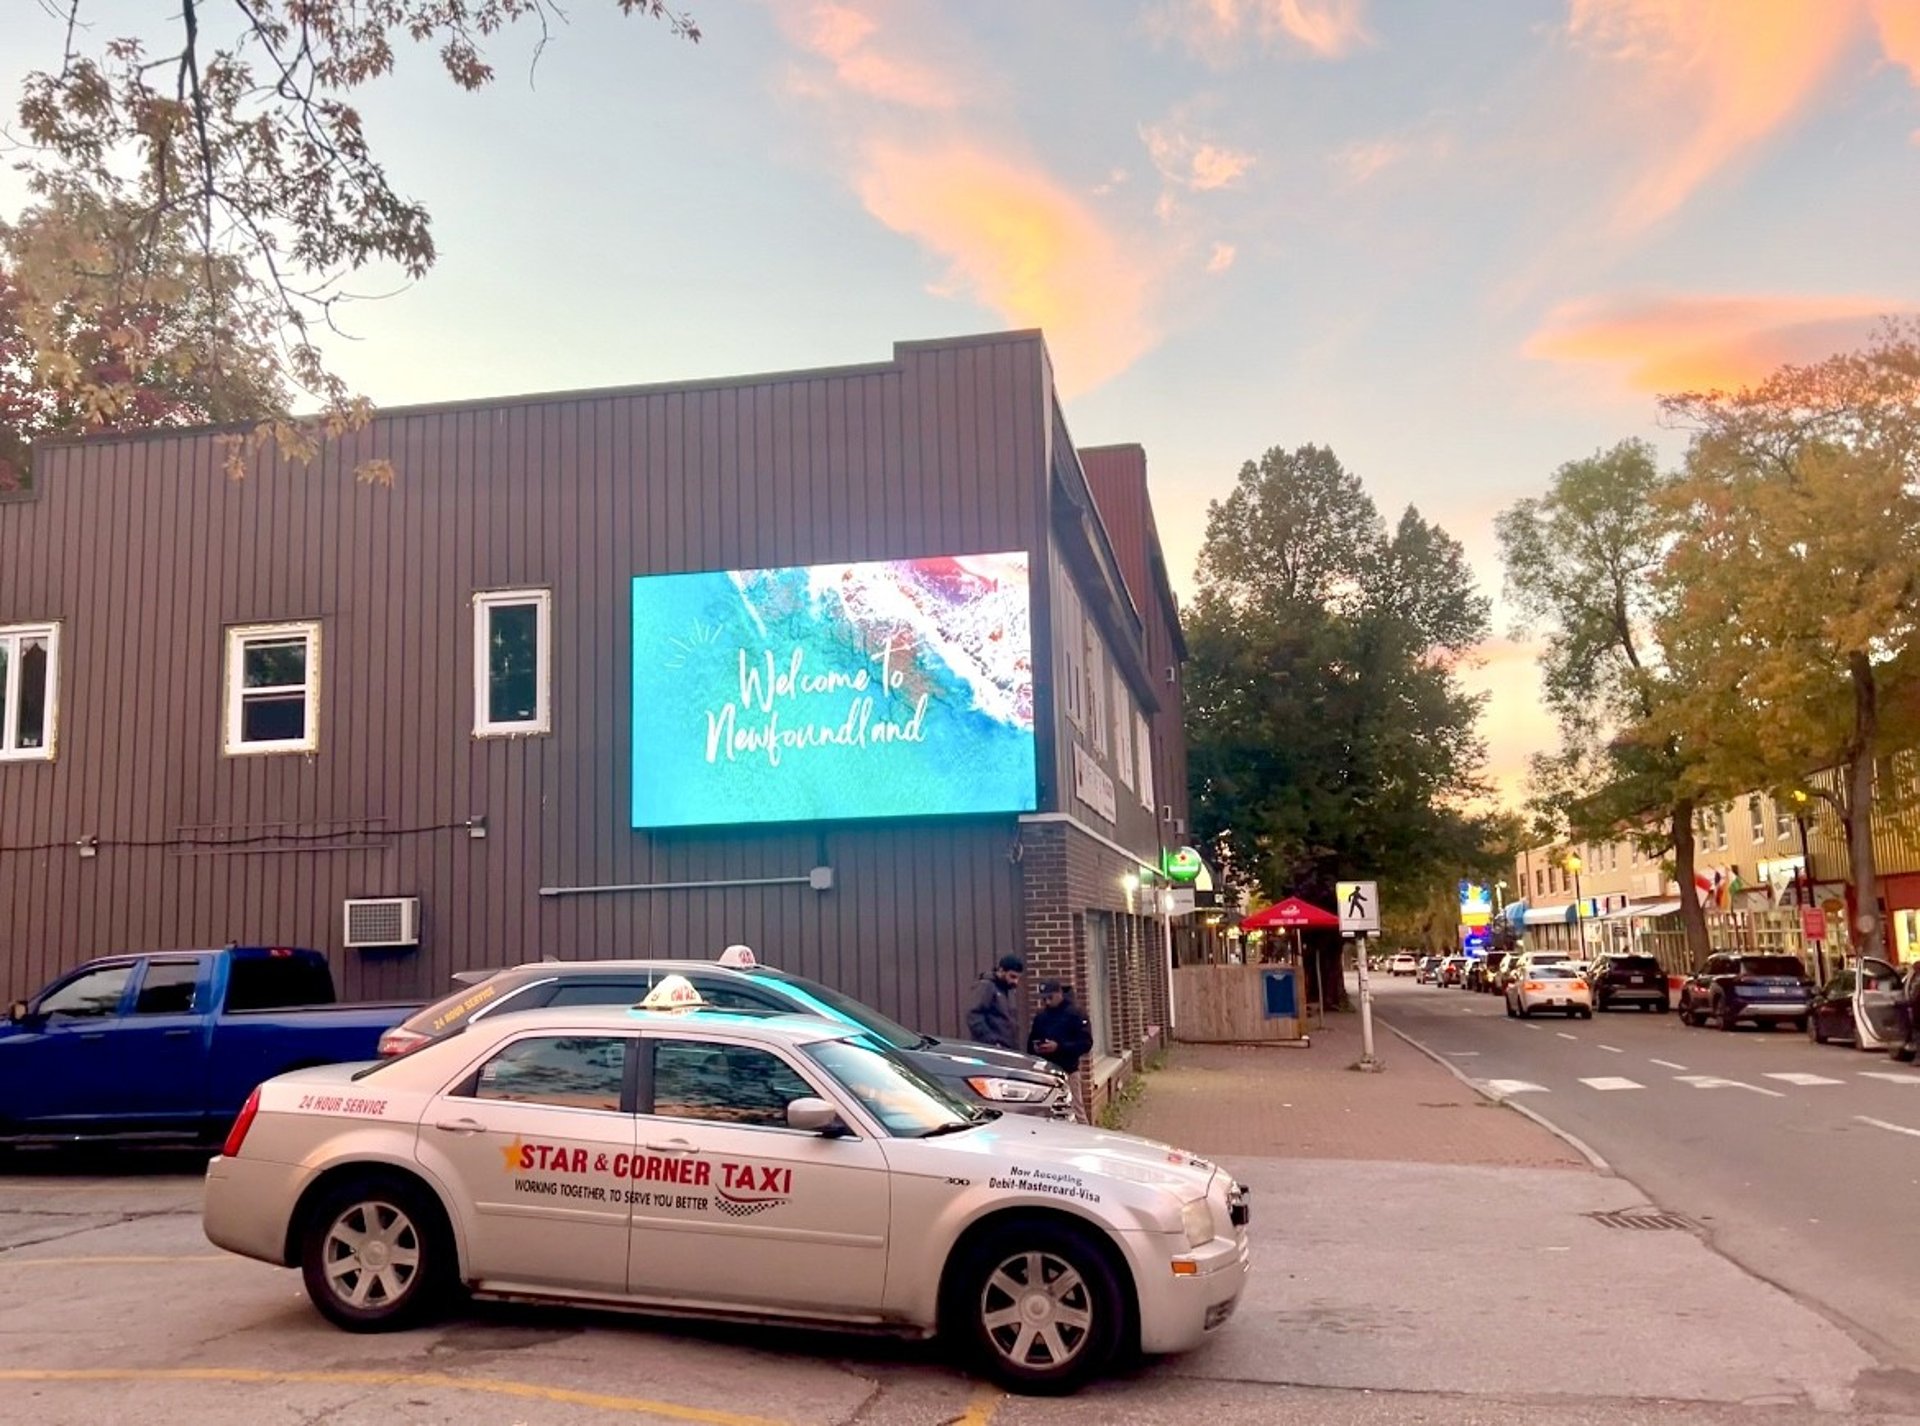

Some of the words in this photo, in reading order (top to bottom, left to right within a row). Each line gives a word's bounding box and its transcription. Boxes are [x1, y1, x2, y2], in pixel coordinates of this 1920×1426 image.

[739, 647, 870, 712] Welcome
[705, 694, 928, 767] Newfoundland
[299, 1095, 314, 1110] 24
[314, 1096, 344, 1112] HOUR
[343, 1098, 388, 1115] SERVICE
[519, 1143, 589, 1173] STAR
[594, 1152, 610, 1172] &
[612, 1152, 711, 1186] CORNER
[721, 1163, 792, 1194] TAXI
[1010, 1166, 1031, 1177] Now
[1033, 1169, 1083, 1187] Accepting
[514, 1178, 557, 1195] WORKING
[560, 1183, 606, 1202] TOGETHER,
[609, 1188, 621, 1202] TO
[624, 1190, 651, 1206] SERVE
[653, 1193, 674, 1208] YOU
[675, 1195, 709, 1211] BETTER
